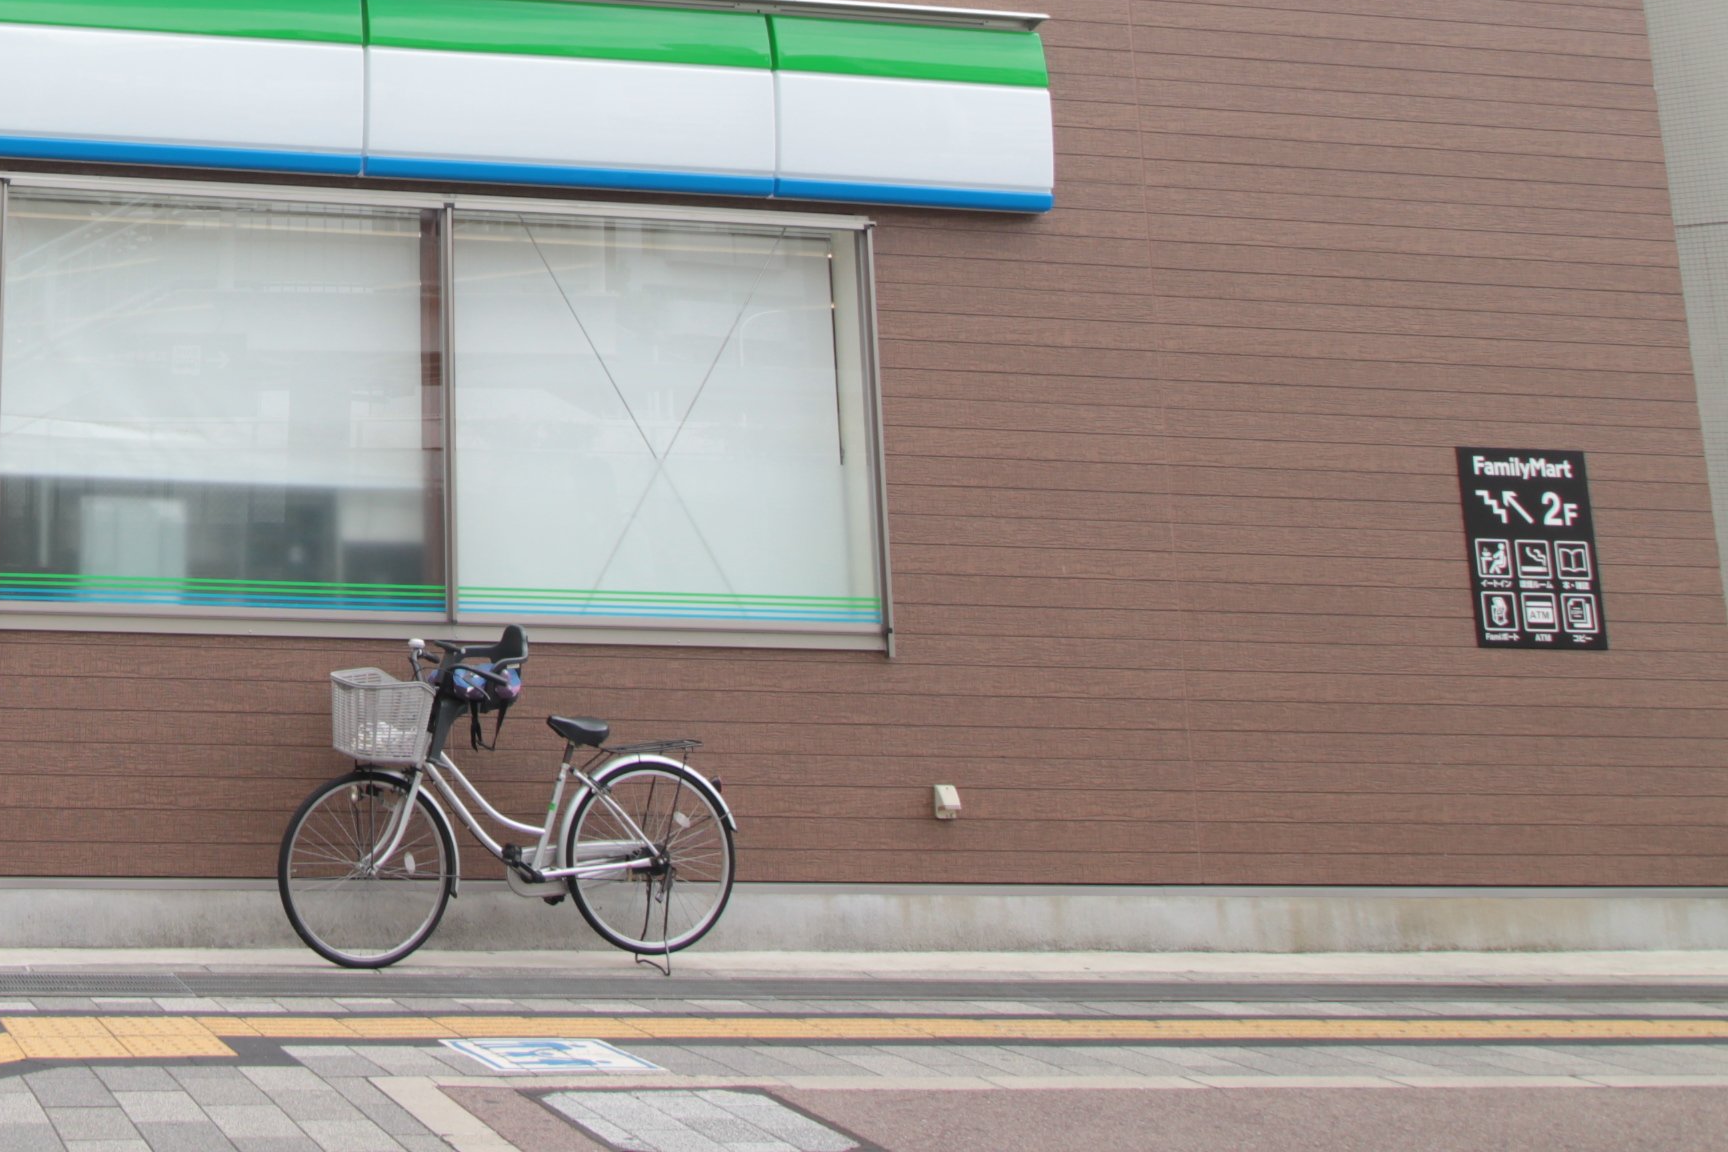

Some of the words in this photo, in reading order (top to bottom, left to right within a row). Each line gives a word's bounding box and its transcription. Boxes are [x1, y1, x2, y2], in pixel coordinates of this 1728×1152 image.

[1472, 454, 1574, 480] FamilyMart
[1541, 491, 1579, 526] 2F
[1529, 610, 1551, 621] ATM
[1535, 634, 1552, 643] ATM
[1572, 635, 1593, 644] コピー
